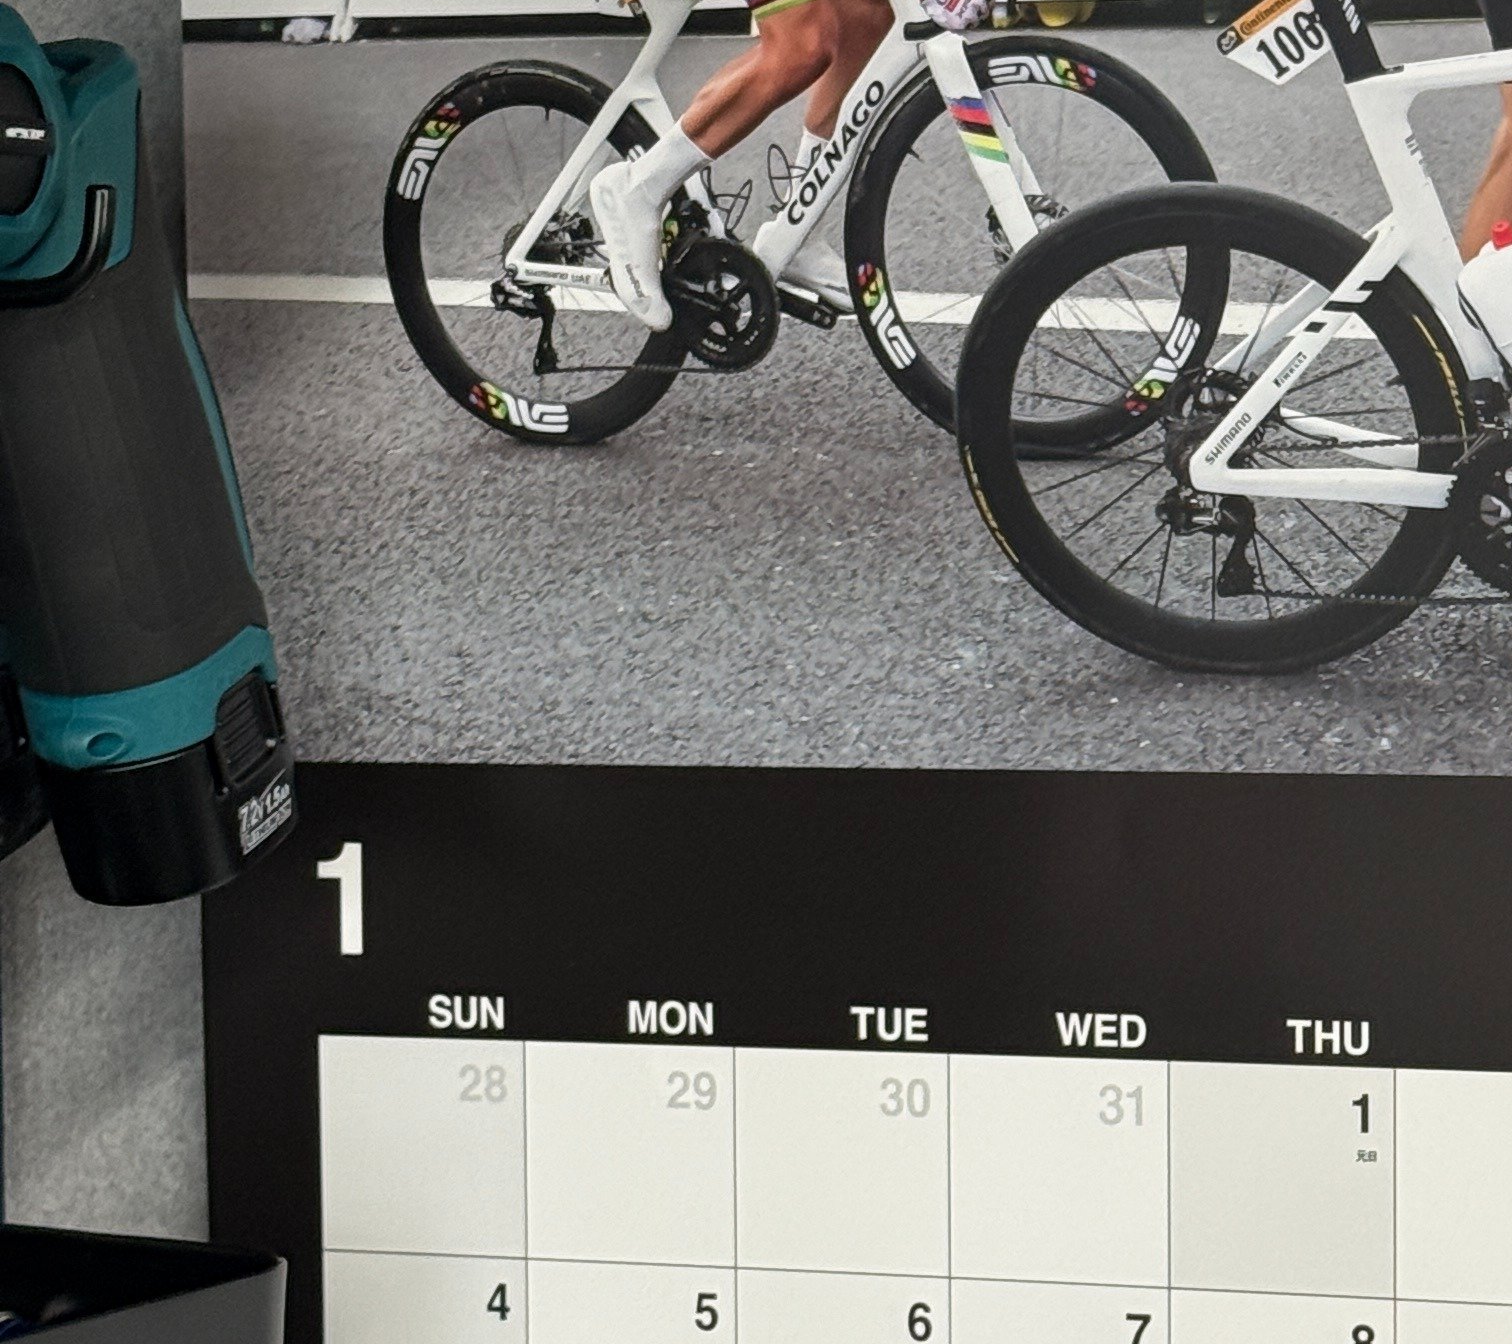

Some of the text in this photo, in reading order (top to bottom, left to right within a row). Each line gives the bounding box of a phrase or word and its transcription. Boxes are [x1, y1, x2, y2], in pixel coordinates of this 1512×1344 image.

[787, 79, 885, 226] COLNAGO
[1203, 411, 1253, 466] SHIMANO
[317, 842, 364, 955] 1
[428, 994, 505, 1029] SUN
[628, 1000, 714, 1035] MON
[850, 1006, 929, 1042] TUE
[1055, 1012, 1147, 1048] WED
[1286, 1019, 1370, 1056] THU
[459, 1064, 507, 1104] 28
[666, 1070, 717, 1111] 29
[880, 1077, 931, 1118] 30
[1098, 1083, 1146, 1127] 31
[1351, 1092, 1370, 1135] 1
[485, 1282, 512, 1322] 4
[694, 1291, 720, 1332] 5
[907, 1301, 933, 1343] 6
